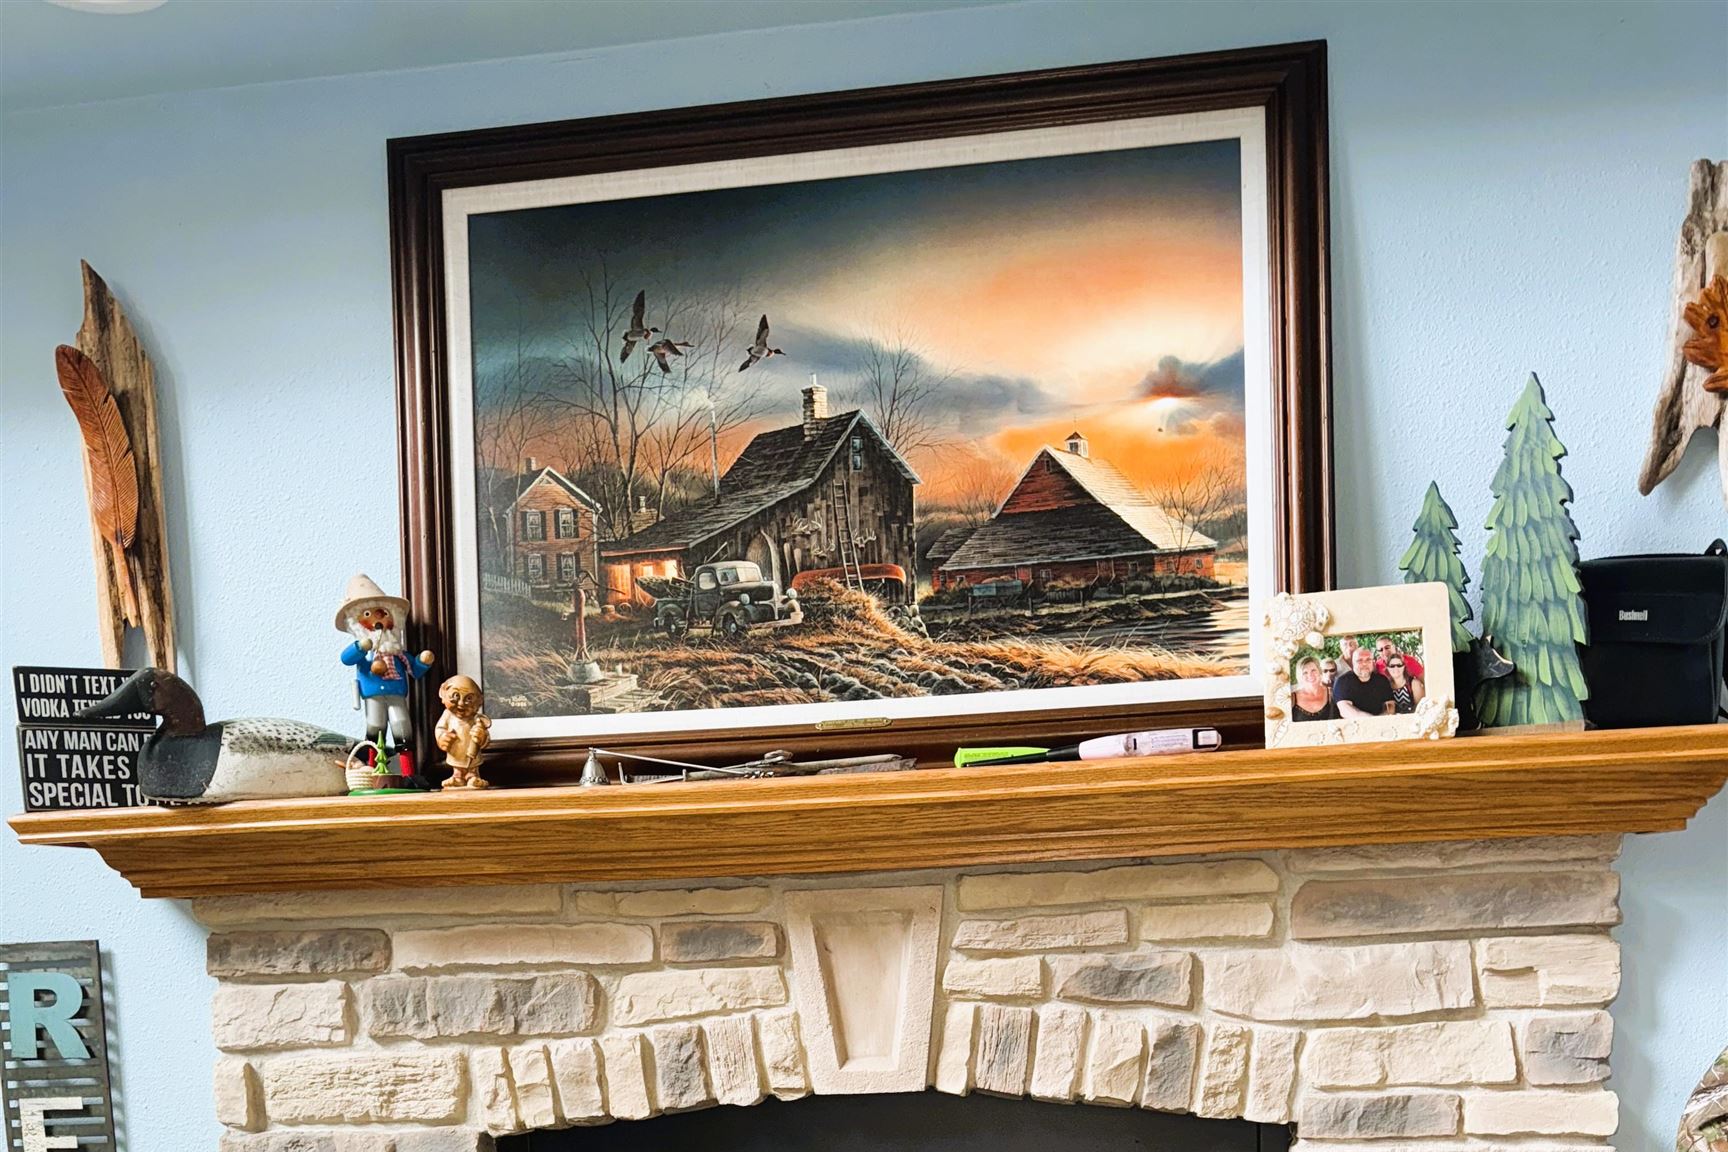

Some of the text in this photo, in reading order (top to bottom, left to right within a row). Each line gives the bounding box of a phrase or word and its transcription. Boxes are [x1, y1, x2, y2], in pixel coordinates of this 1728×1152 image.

[19, 673, 25, 693] I
[29, 673, 78, 694] DIDN'T
[82, 675, 116, 695] TEXT
[21, 698, 70, 718] VODKA
[25, 730, 59, 750] ANY
[63, 730, 102, 750] MAN
[106, 732, 140, 752] CAN
[26, 753, 131, 779] IT TAKES
[29, 781, 119, 807] SPECIAL
